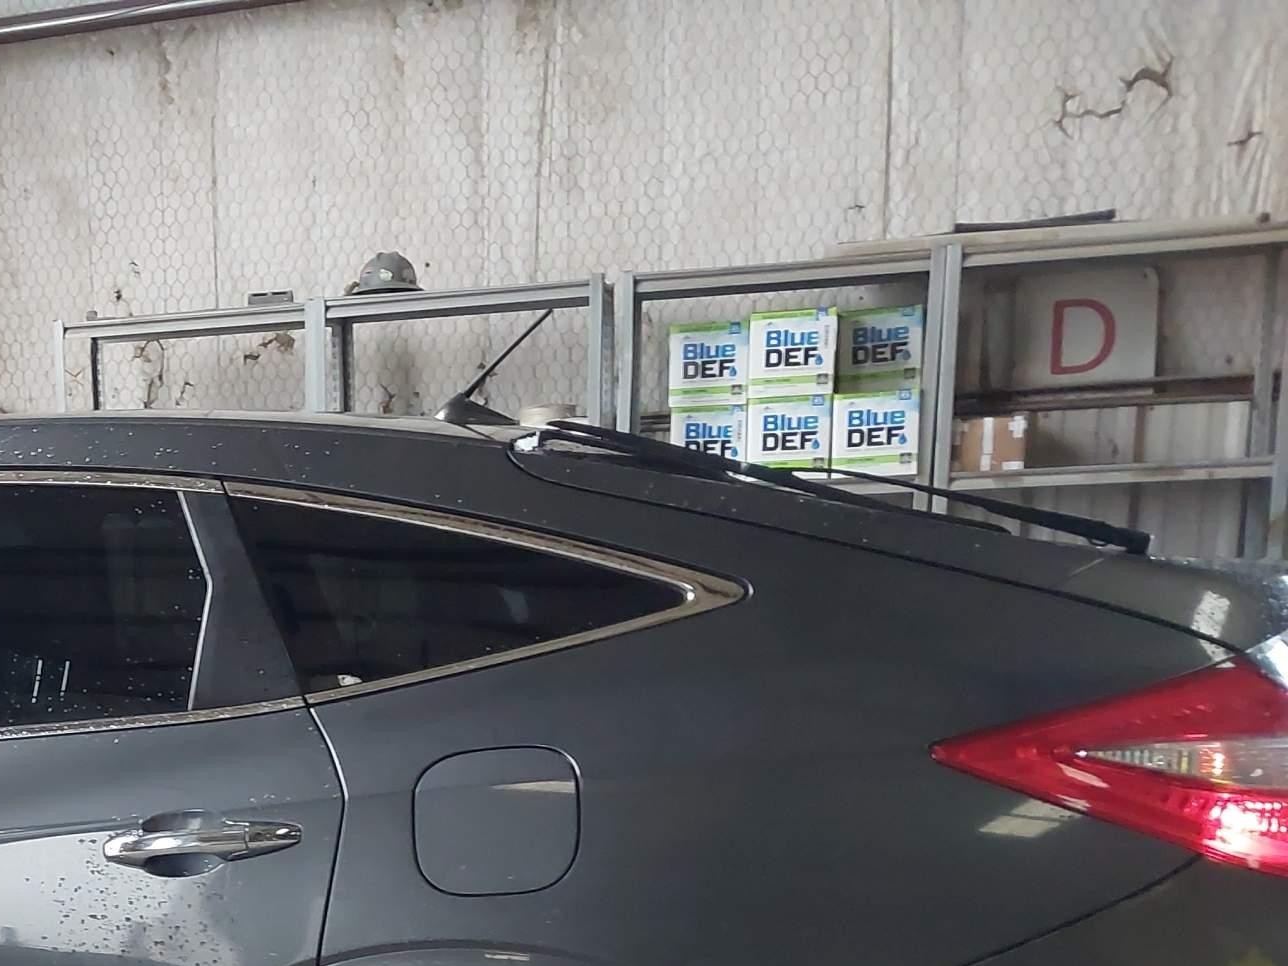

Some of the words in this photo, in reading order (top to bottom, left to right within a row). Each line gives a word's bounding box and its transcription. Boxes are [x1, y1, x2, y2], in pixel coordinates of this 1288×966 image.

[765, 329, 819, 348] Blue
[852, 326, 910, 345] Blue
[1050, 299, 1116, 375] D
[683, 342, 736, 361] Blue
[764, 346, 819, 368] DEF
[852, 341, 909, 365] DEF
[683, 358, 736, 379] DEF
[763, 414, 819, 432] Blue
[847, 409, 906, 428] Blue
[685, 422, 733, 440] Blue
[761, 430, 819, 452] DEF
[846, 425, 906, 448] DEF
